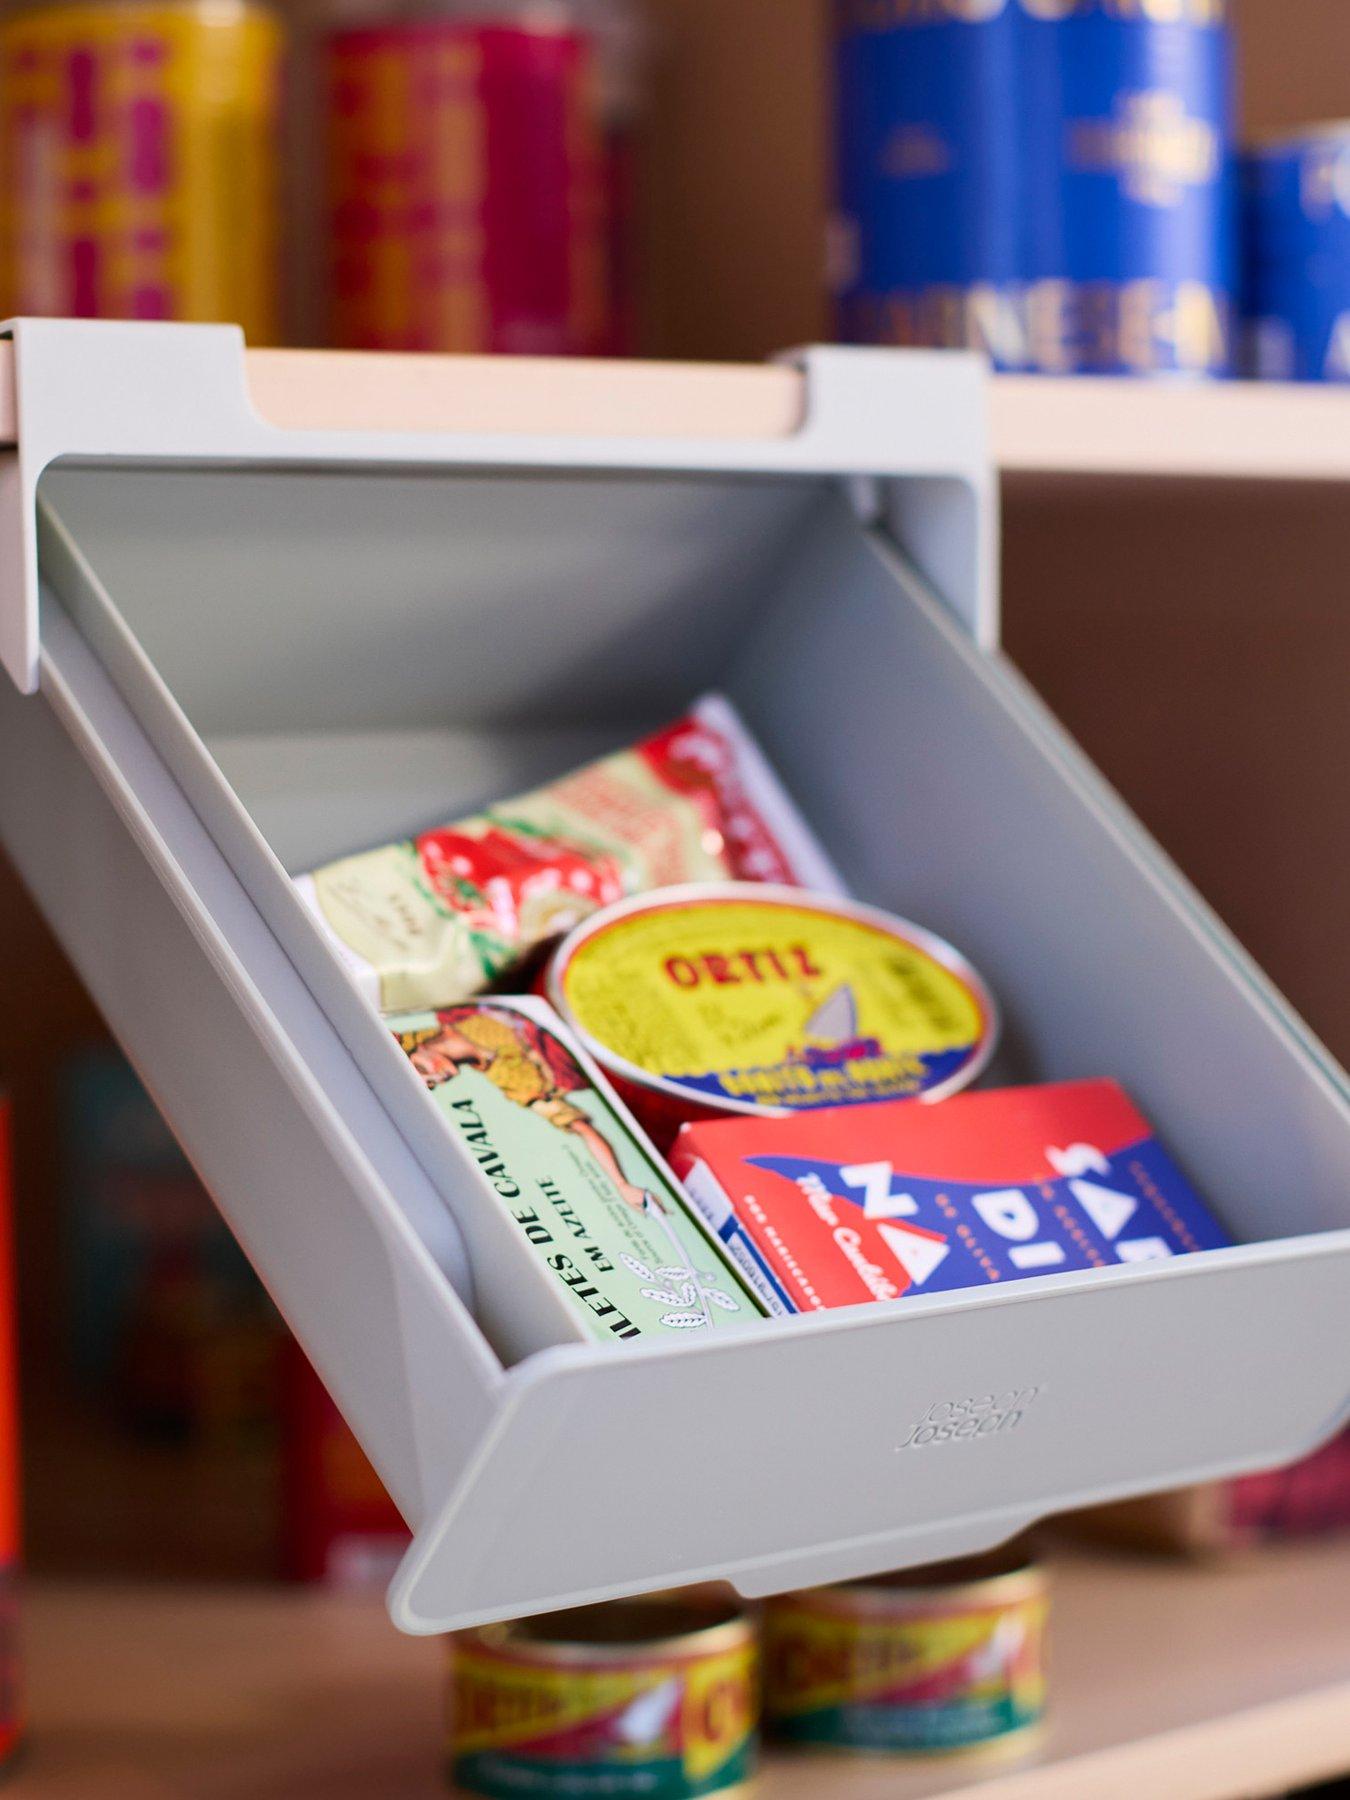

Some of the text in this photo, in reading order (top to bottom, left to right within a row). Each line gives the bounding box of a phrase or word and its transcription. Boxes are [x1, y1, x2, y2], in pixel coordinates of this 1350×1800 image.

[662, 939, 824, 990] ORTIZ
[451, 1098, 520, 1198] CAVALA
[511, 1205, 554, 1245] DE
[536, 1174, 591, 1240] AZEITE
[583, 1245, 615, 1273] EM
[547, 1253, 641, 1339] ILETES
